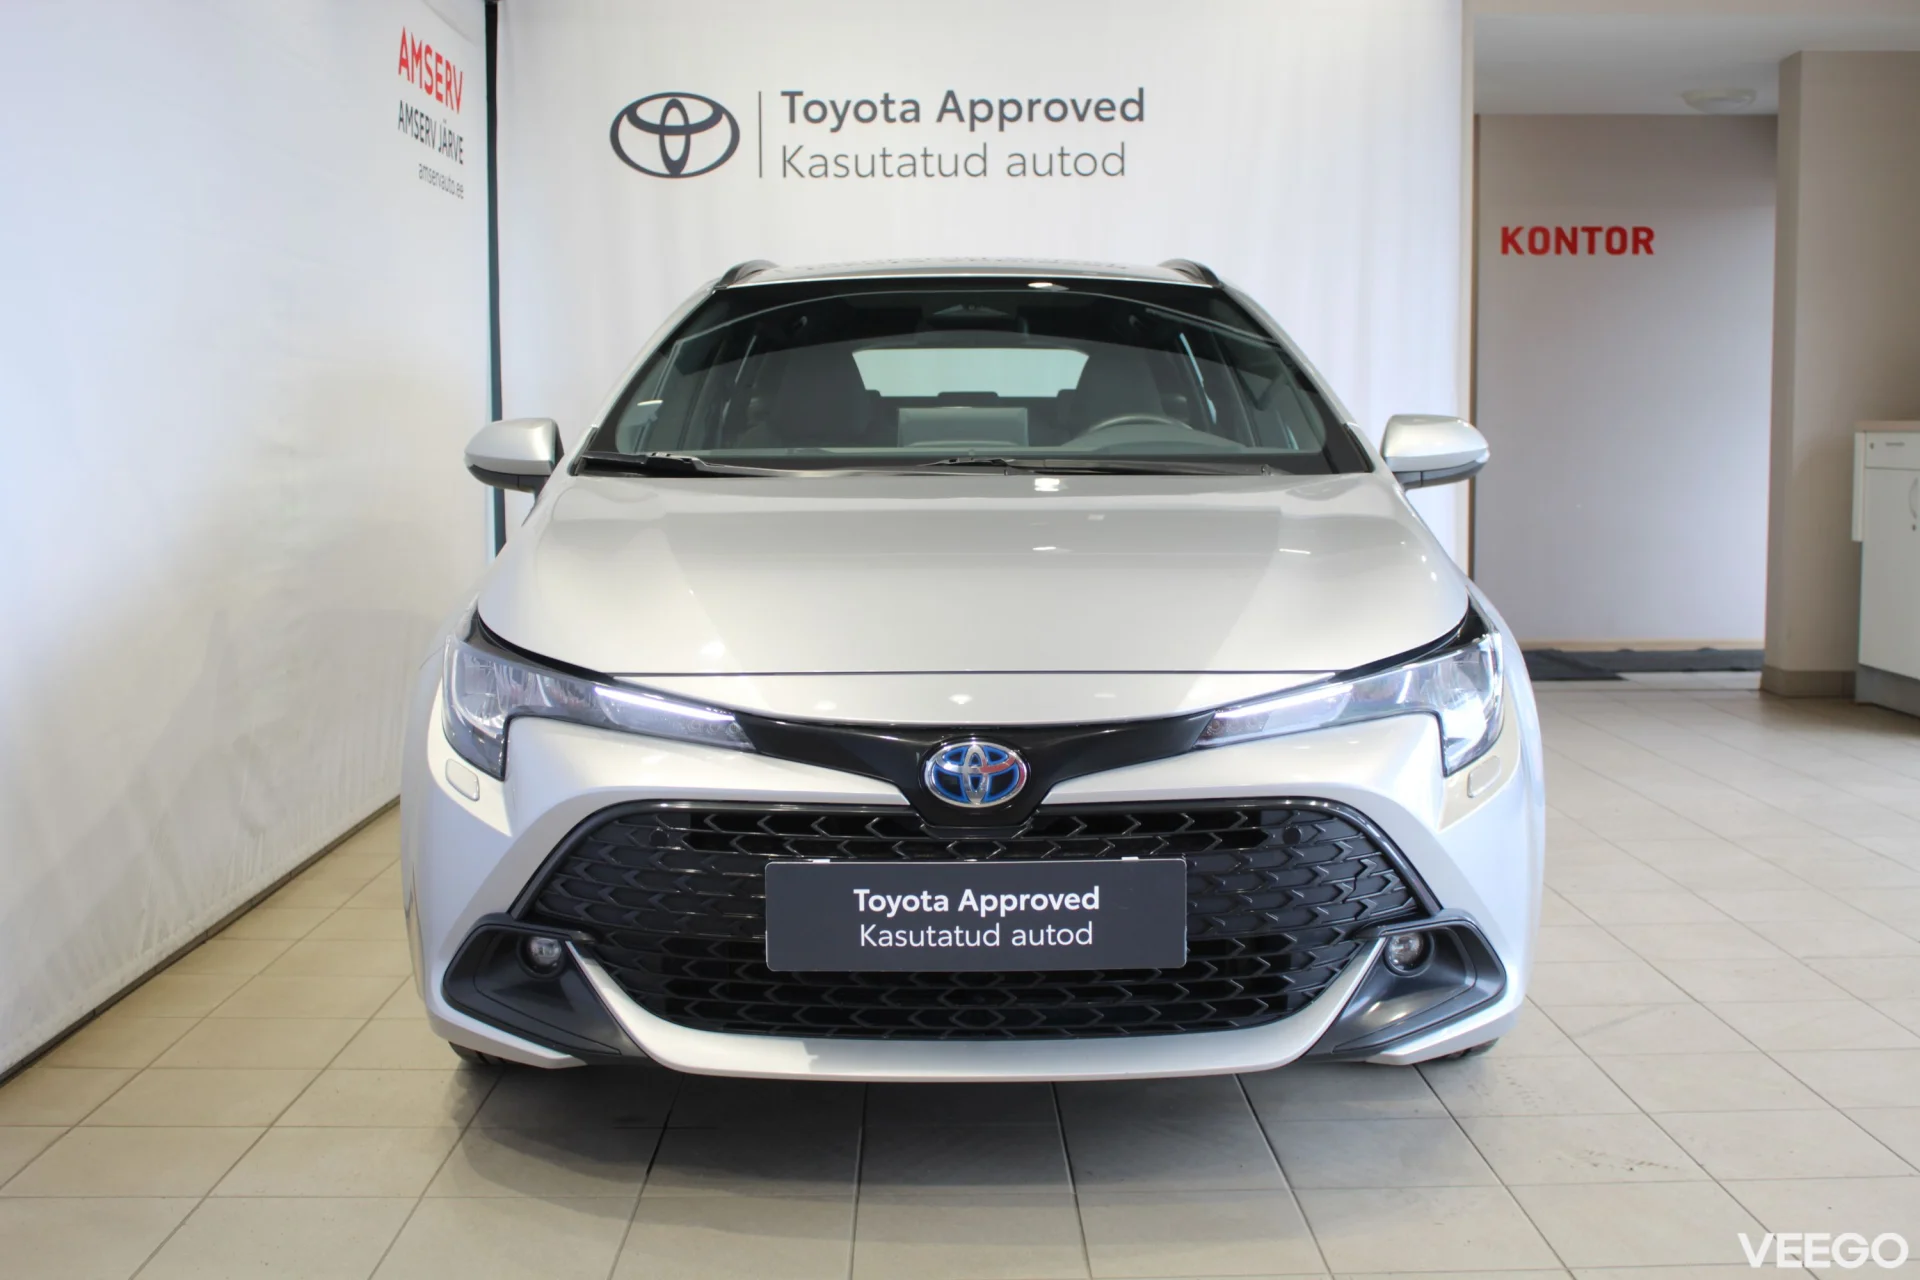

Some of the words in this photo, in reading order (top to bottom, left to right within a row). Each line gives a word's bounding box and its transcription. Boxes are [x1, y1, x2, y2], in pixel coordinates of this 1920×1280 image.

[398, 26, 463, 114] AMSERV
[781, 90, 921, 133] Toyota
[936, 88, 1145, 133] Approved
[398, 100, 437, 150] AMSERV
[438, 118, 464, 165] JÄRVE
[781, 142, 989, 179] Kasutatud
[1005, 142, 1127, 178] autod
[418, 163, 464, 200] amservauto.ee
[1500, 225, 1655, 256] KONTOR
[853, 889, 949, 917] Toyota
[957, 885, 1100, 917] Approved
[859, 923, 1000, 948] Kasutatud
[1011, 921, 1094, 947] autod
